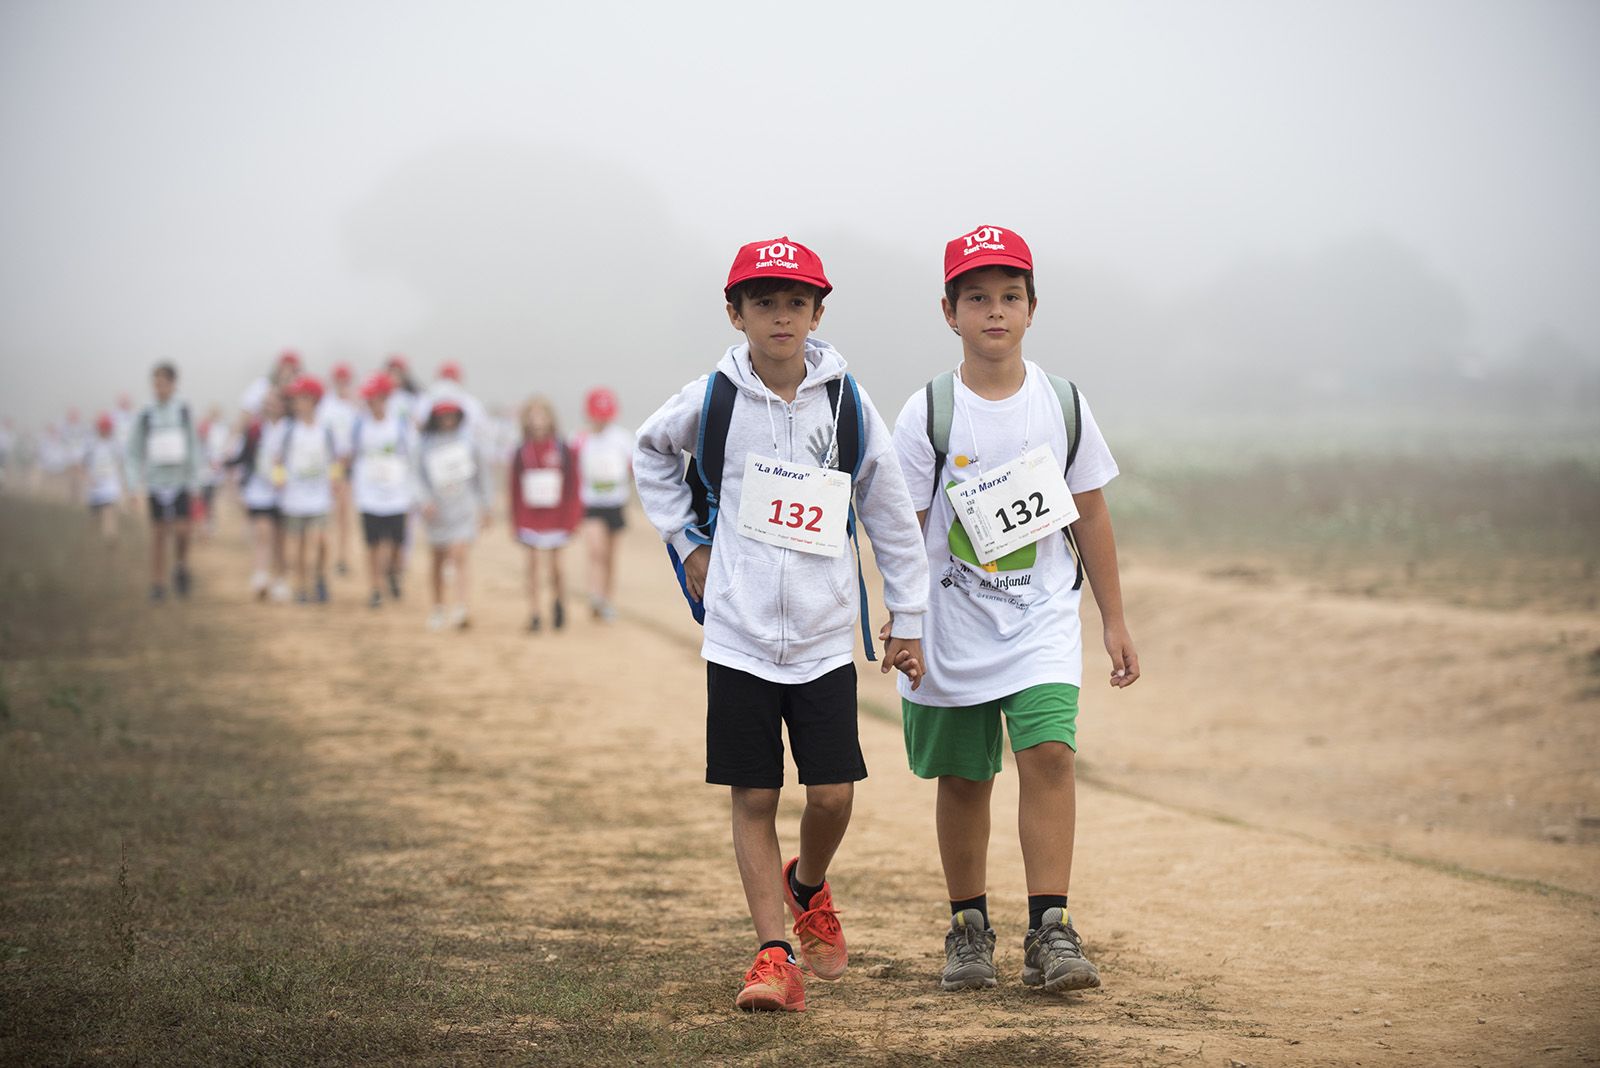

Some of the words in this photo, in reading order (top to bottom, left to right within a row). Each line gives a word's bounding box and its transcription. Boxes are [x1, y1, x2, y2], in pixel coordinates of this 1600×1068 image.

[964, 227, 1002, 247] TOT
[756, 242, 797, 260] TOT
[756, 260, 773, 269] Sant
[776, 260, 799, 269] Cugat
[772, 467, 810, 480] Marxa”
[768, 499, 823, 533] 132
[995, 491, 1050, 534] 132
[994, 574, 1031, 590] Infantil
